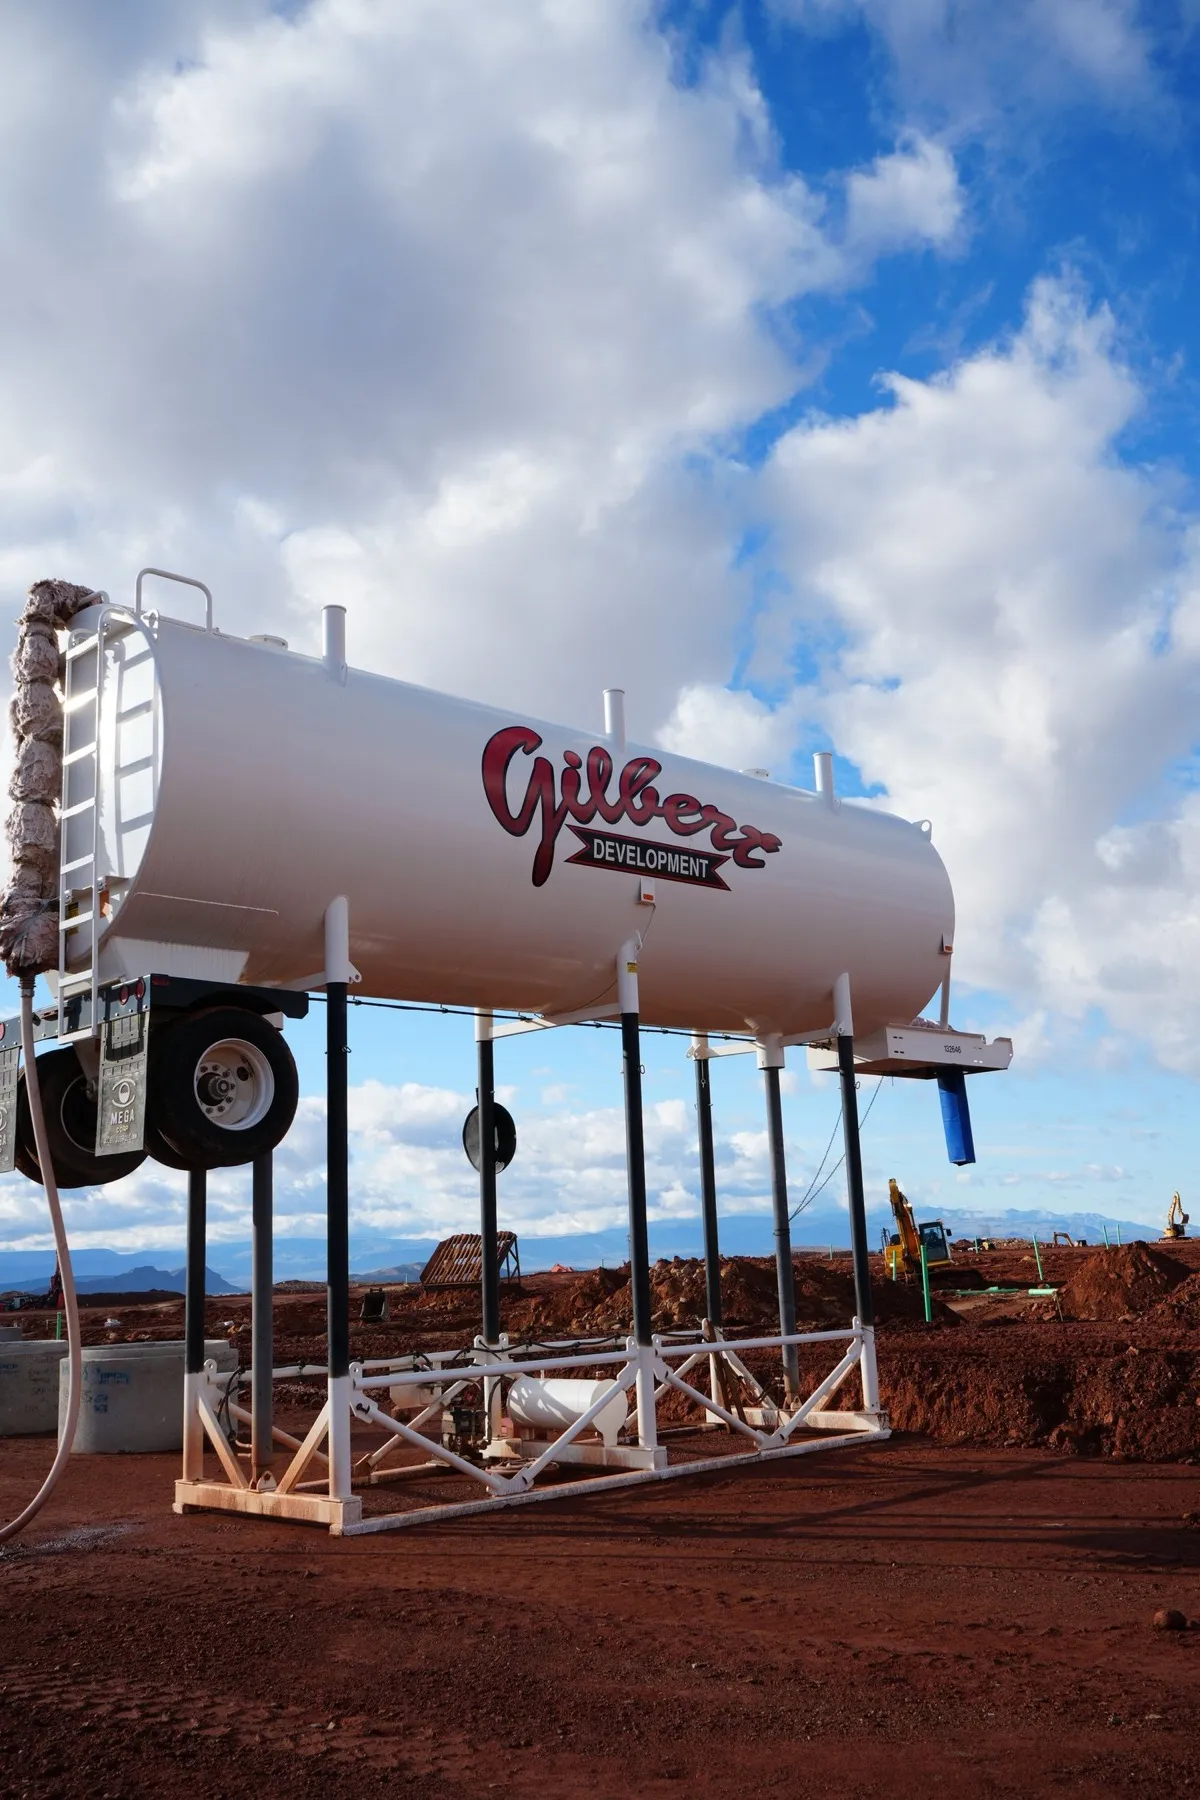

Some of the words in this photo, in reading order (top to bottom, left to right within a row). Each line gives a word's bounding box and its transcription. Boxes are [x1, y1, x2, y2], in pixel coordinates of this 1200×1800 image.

[481, 726, 783, 887] Gilbert
[593, 838, 709, 878] DEVELOPMENT
[110, 1108, 135, 1125] MEGA
